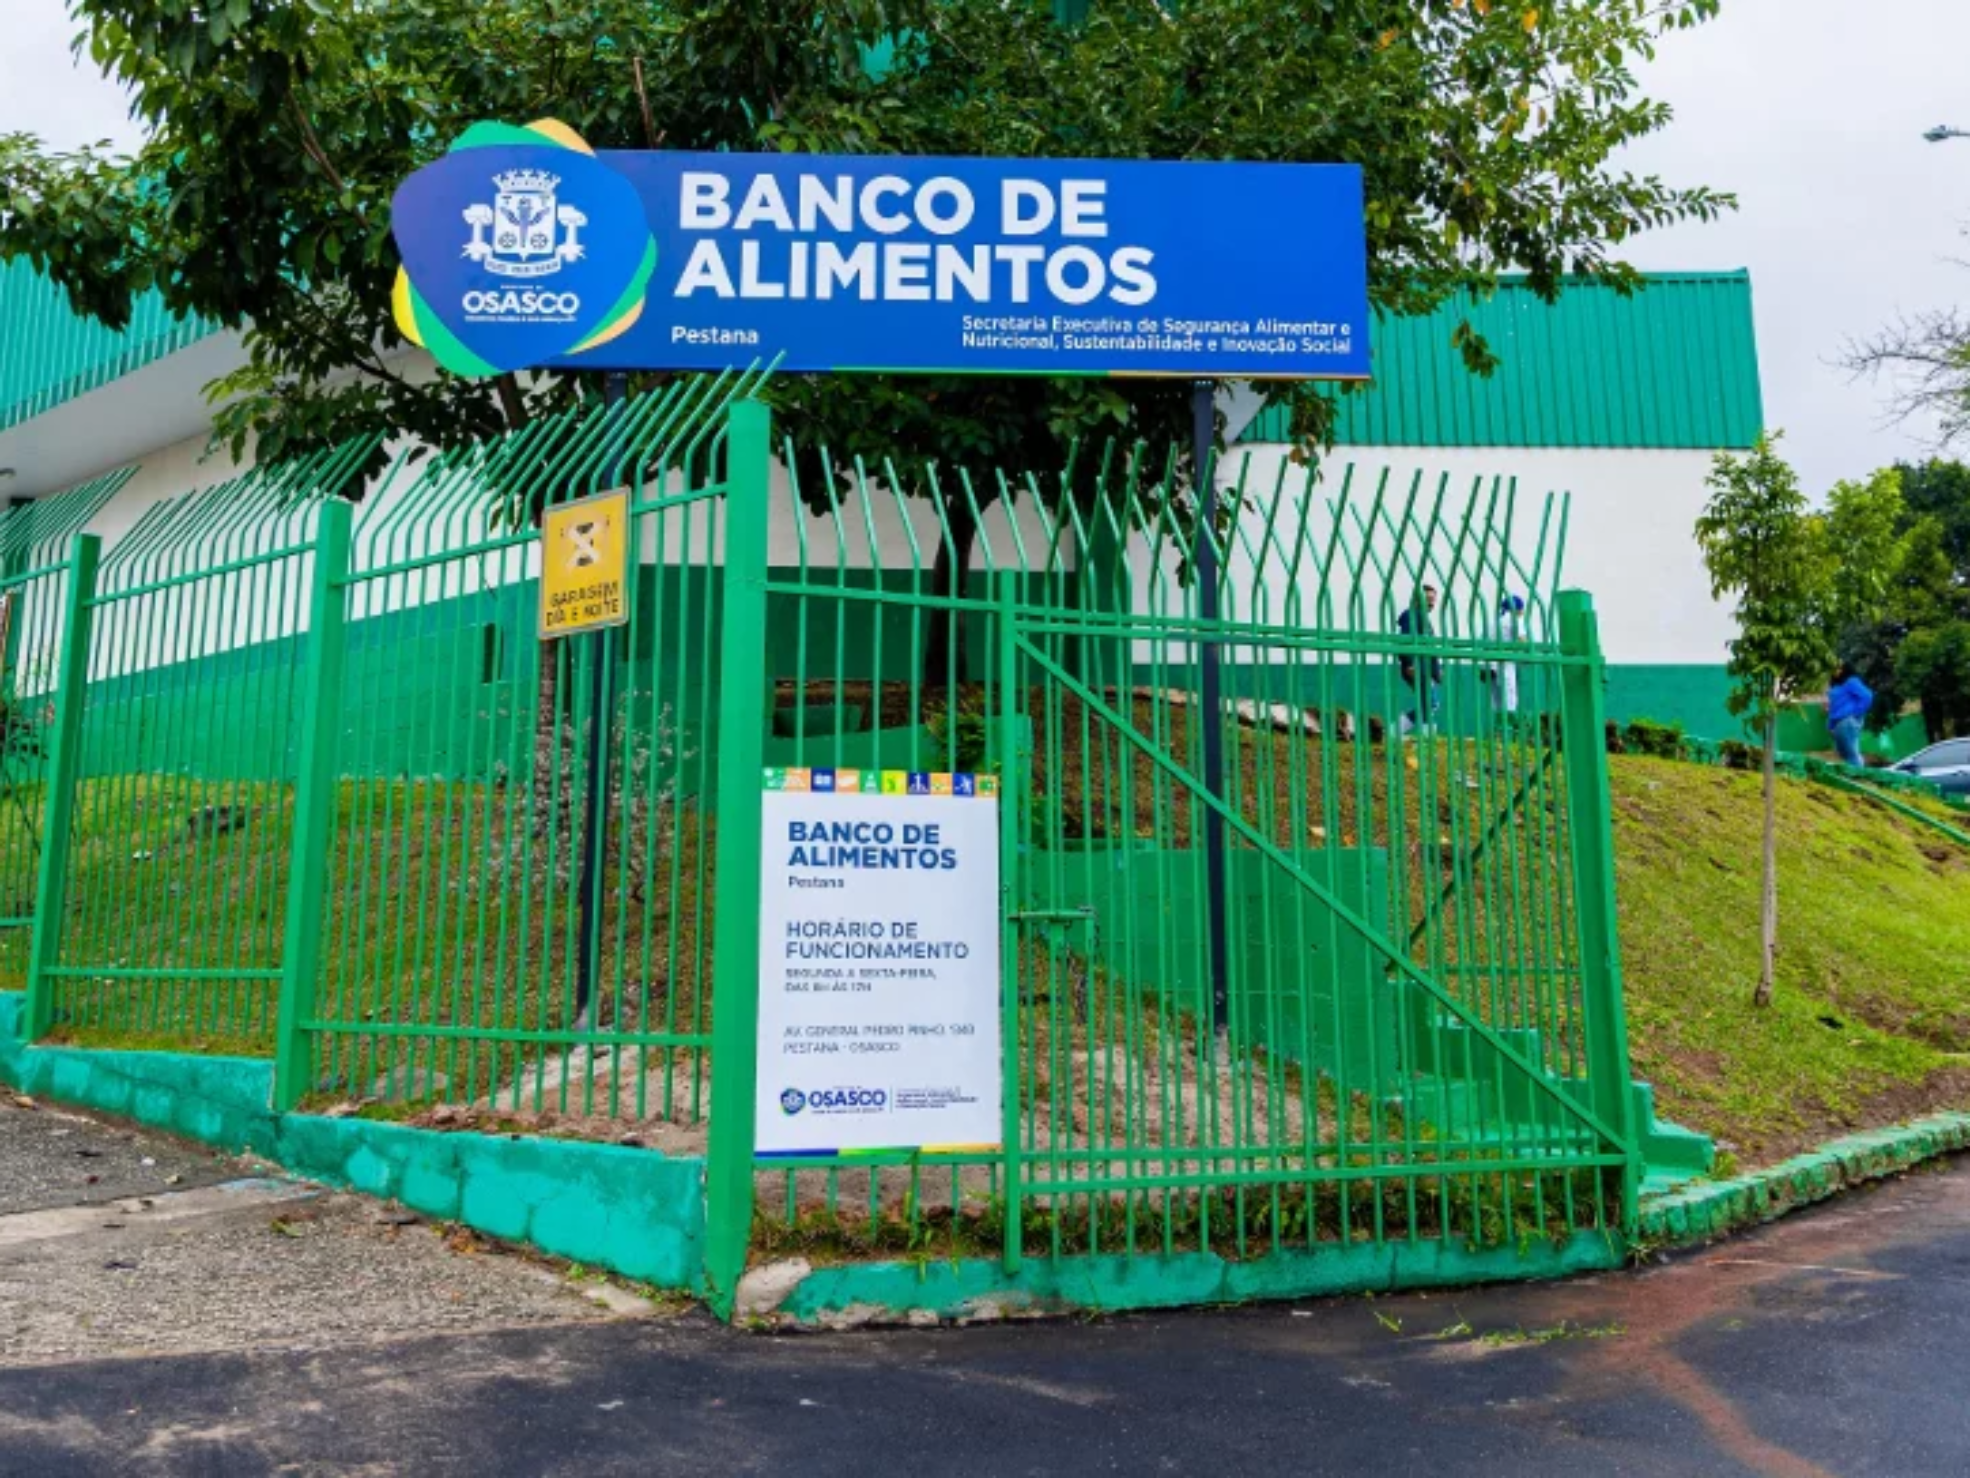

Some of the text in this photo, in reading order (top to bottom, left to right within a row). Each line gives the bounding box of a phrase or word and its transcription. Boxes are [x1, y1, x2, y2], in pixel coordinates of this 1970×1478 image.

[679, 171, 1108, 237] BANCO DE
[674, 239, 1158, 305] ALIMENTOS
[462, 291, 580, 314] OSASCO
[672, 326, 760, 345] Pestana
[962, 315, 1047, 331] Secretaria
[1053, 316, 1132, 333] Executiva
[1137, 318, 1158, 333] de
[1255, 318, 1337, 335] Alimentar
[1341, 323, 1351, 335] e
[962, 332, 1351, 354] Nutricional, Sustentabilidade e Inovação Social
[788, 821, 940, 844] BANCO DE
[787, 846, 957, 869] ALIMENTOS
[788, 875, 845, 888] Pestana
[786, 918, 918, 938] HORÁRIO DE
[786, 941, 969, 959] FUNCIONAMENTO
[808, 1090, 888, 1109] OSASCO
